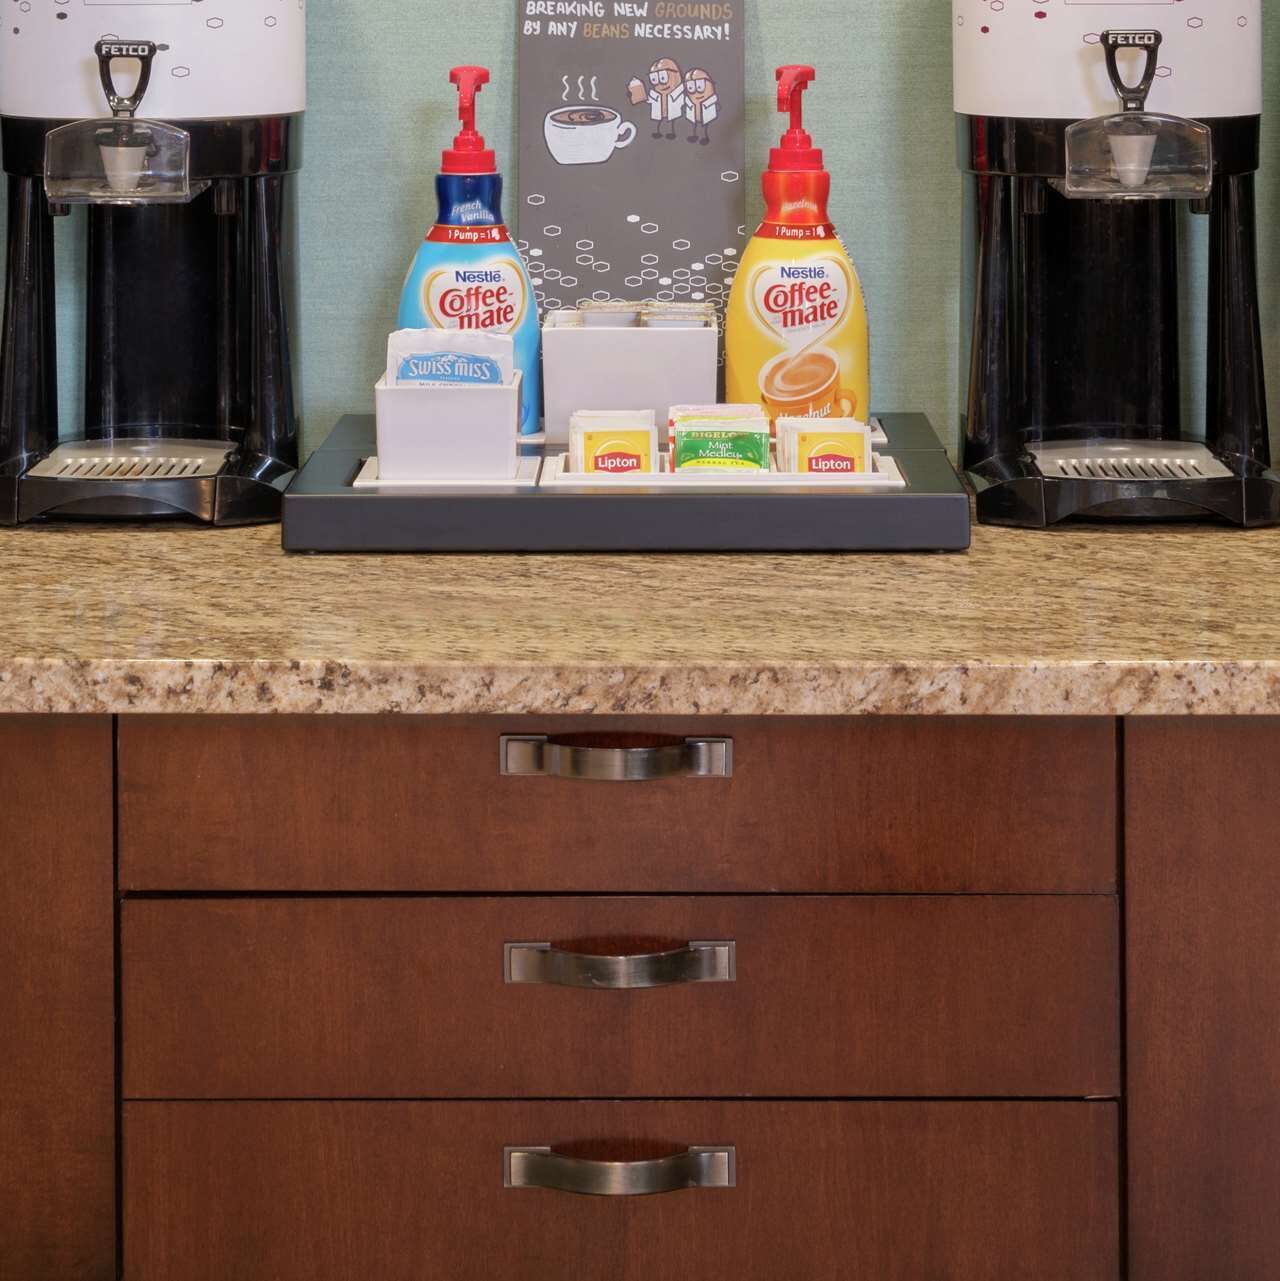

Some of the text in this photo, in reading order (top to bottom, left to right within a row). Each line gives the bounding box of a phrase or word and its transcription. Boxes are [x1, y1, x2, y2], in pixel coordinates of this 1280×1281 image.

[526, 0, 734, 20] BREAKING NEW GROUNDS
[523, 20, 730, 41] BY ANY BEANS NECESSARY!
[1108, 33, 1155, 45] FETCO
[101, 44, 149, 56] FETCO
[451, 200, 481, 216] French
[454, 230, 479, 242] Pump
[781, 227, 804, 239] Pump
[458, 304, 514, 330] mate
[782, 299, 839, 328] mate
[598, 456, 637, 471] Lipton
[811, 458, 852, 472] Lipton
